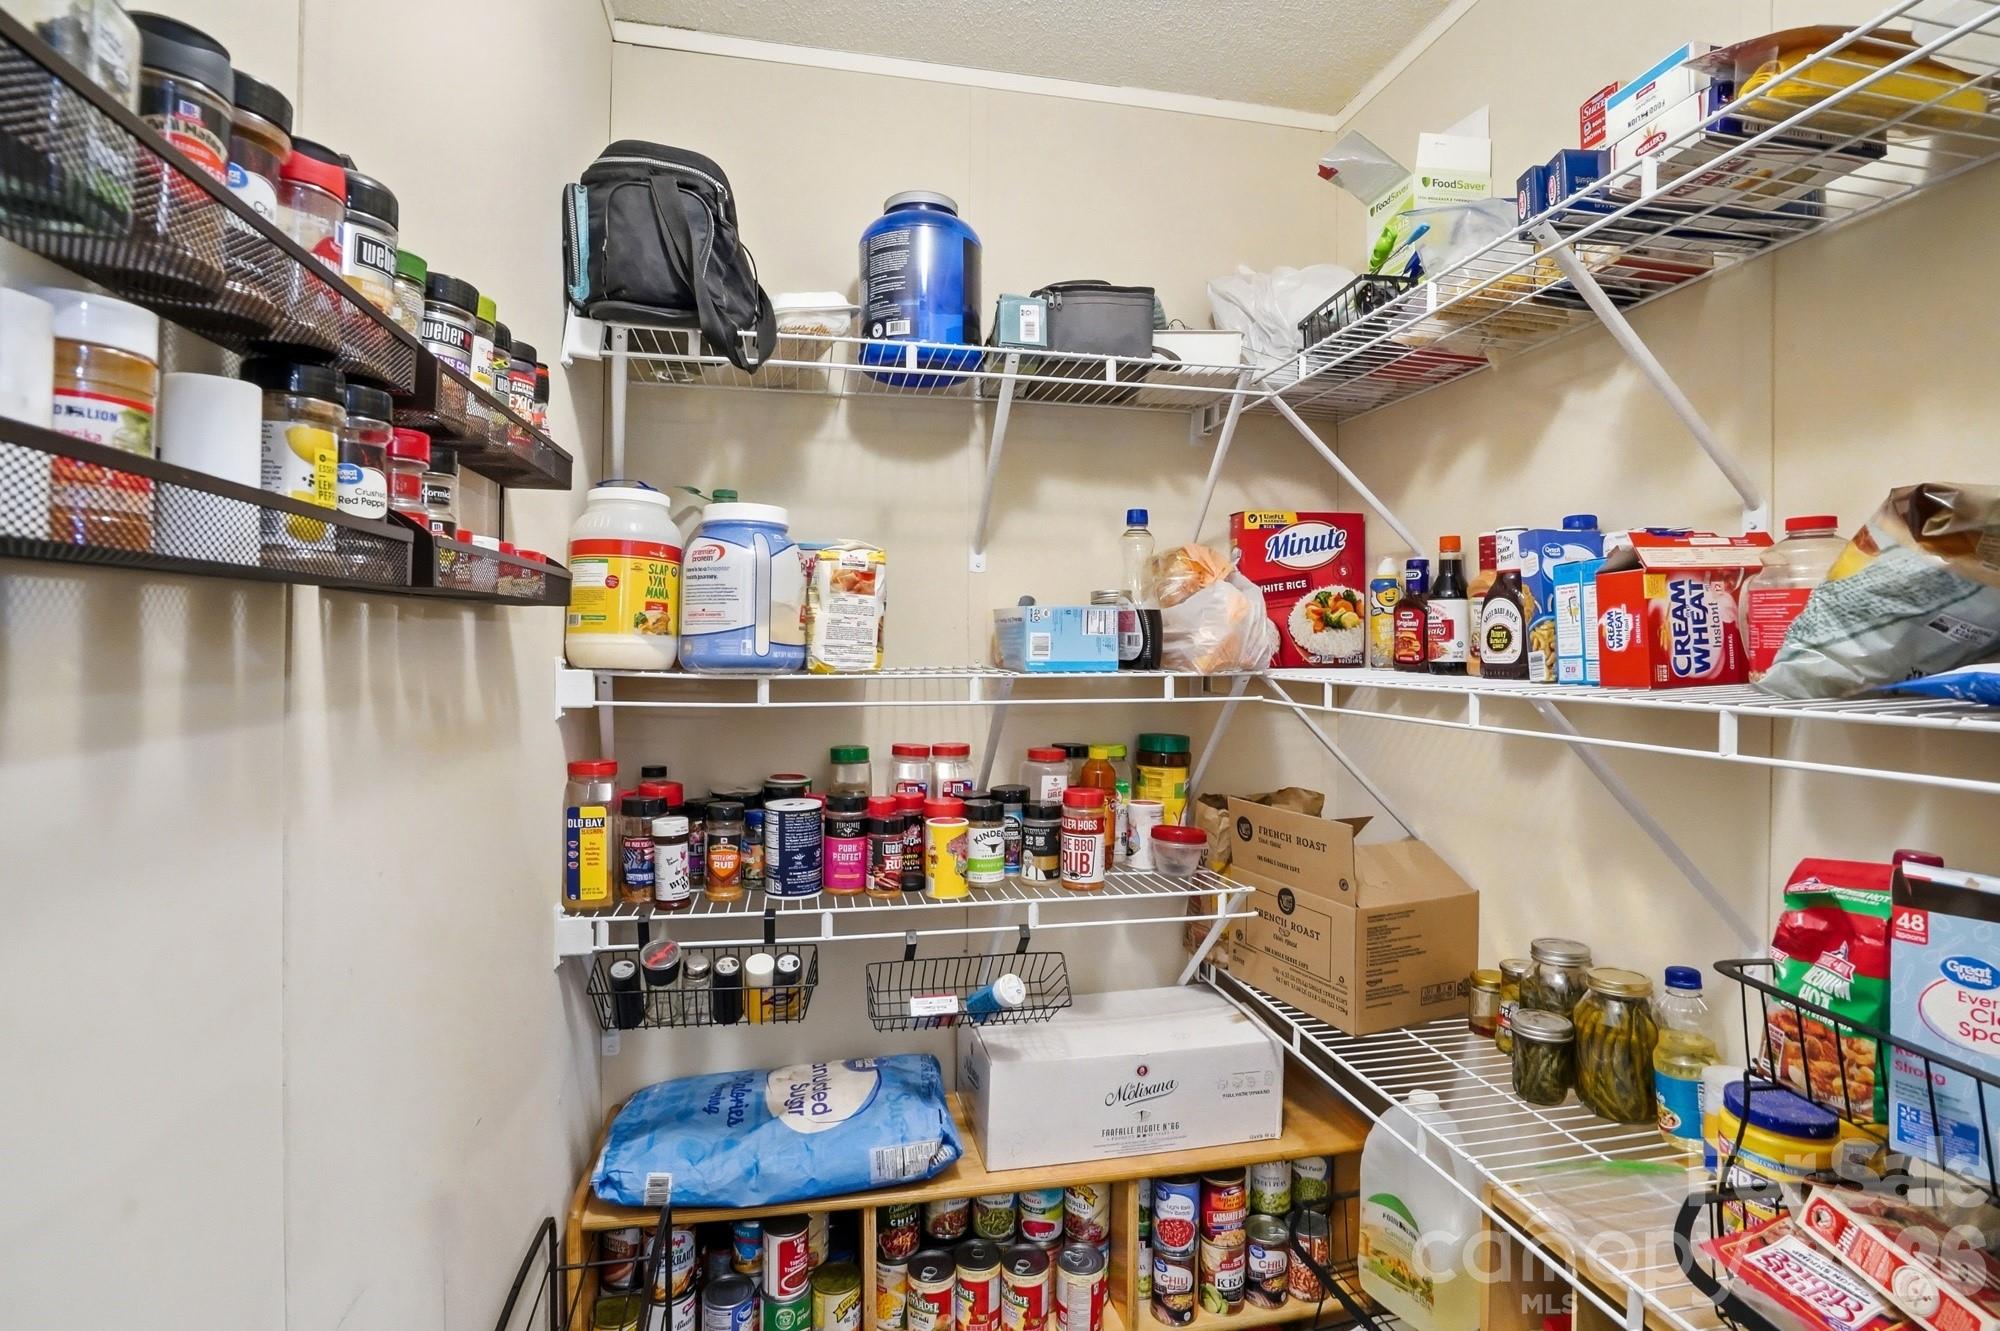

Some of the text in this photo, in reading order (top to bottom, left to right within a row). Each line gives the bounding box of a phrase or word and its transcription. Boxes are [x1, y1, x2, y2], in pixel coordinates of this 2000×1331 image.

[1432, 178, 1485, 191] FoodSaver
[1375, 183, 1409, 214] FoodSaver
[422, 321, 464, 347] weber
[86, 407, 118, 423] LION
[338, 495, 359, 505] Red
[1266, 528, 1345, 561] Minute
[691, 555, 714, 563] protein
[648, 563, 669, 575] SLAP
[645, 586, 669, 599] MAMA
[1286, 579, 1307, 591] RICE
[1606, 611, 1615, 649] CREAM
[1615, 611, 1623, 649] WHEAT
[1669, 579, 1692, 676] CREAM
[1688, 579, 1711, 674] WHEAT
[1708, 601, 1722, 648] Instant
[567, 818, 603, 828] OLD BAY
[1077, 819, 1098, 831] HOGS
[838, 843, 857, 852] PORK
[1258, 825, 1293, 844] FRENCH
[1296, 836, 1327, 853] ROAST
[832, 852, 862, 862] PERFECT
[1062, 851, 1090, 874] RUB
[1896, 912, 1925, 931] 48
[1291, 922, 1321, 941] ROAST
[1946, 960, 1991, 977] Great
[1956, 972, 1992, 986] Value
[1957, 990, 2000, 1010] Ever
[1105, 1079, 1180, 1107] Molisana
[1101, 1127, 1134, 1138] FARFALLE
[1136, 1124, 1160, 1134] RIGATE
[1837, 1220, 1859, 1253] CHILI
